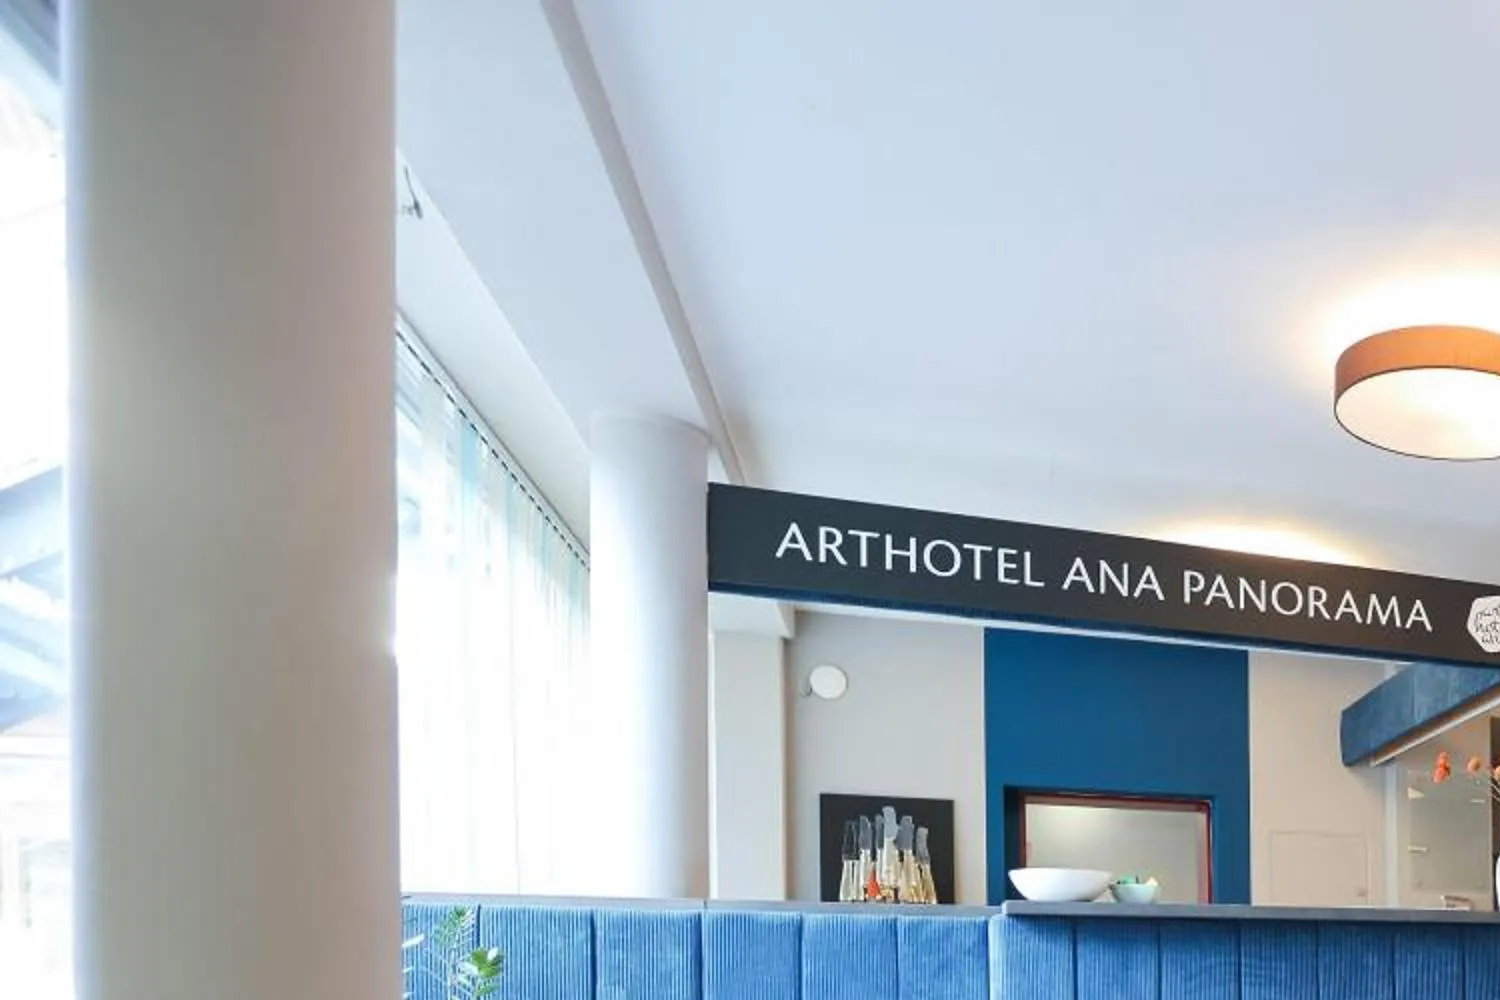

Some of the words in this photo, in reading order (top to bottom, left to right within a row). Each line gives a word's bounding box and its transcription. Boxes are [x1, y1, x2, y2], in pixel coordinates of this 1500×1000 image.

[775, 521, 1045, 588] ARTHOTEL
[1062, 556, 1165, 601] ANA
[1183, 569, 1434, 633] PANORAMA
